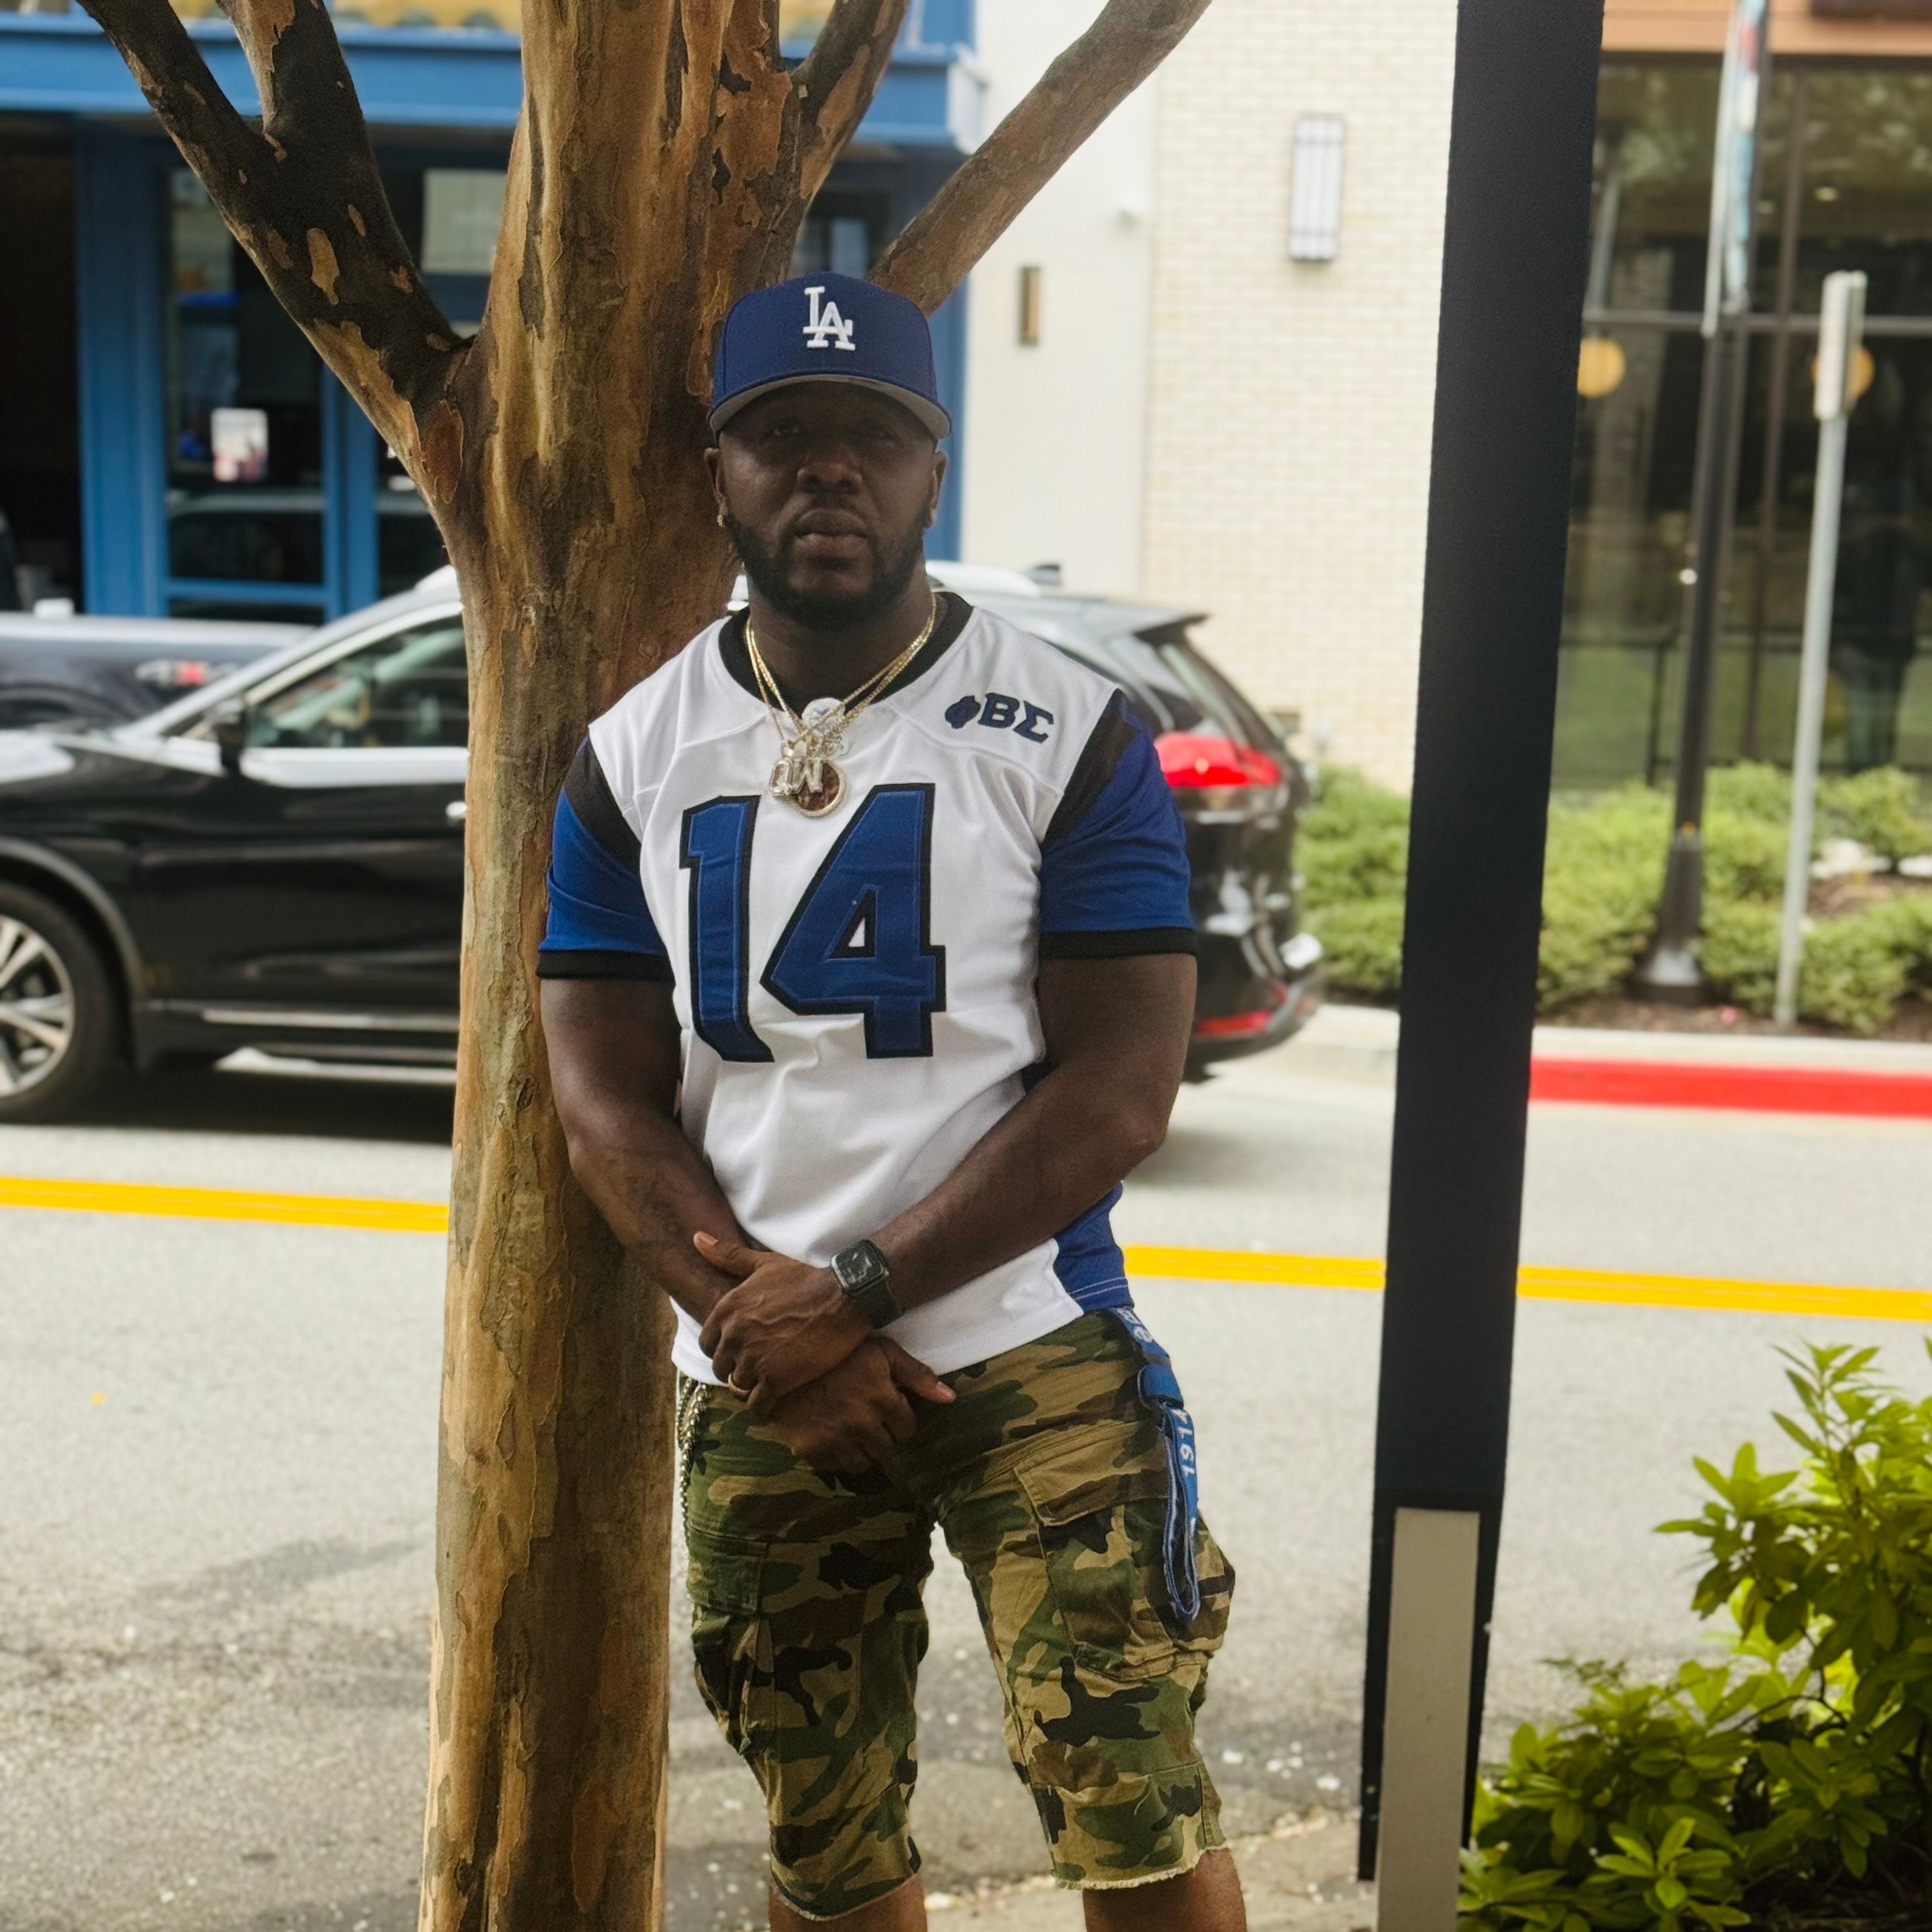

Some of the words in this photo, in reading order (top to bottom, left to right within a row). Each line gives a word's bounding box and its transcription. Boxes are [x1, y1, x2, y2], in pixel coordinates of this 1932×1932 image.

[803, 286, 856, 351] LA
[679, 782, 947, 1063] 14
[1169, 1408, 1196, 1477] 1914
